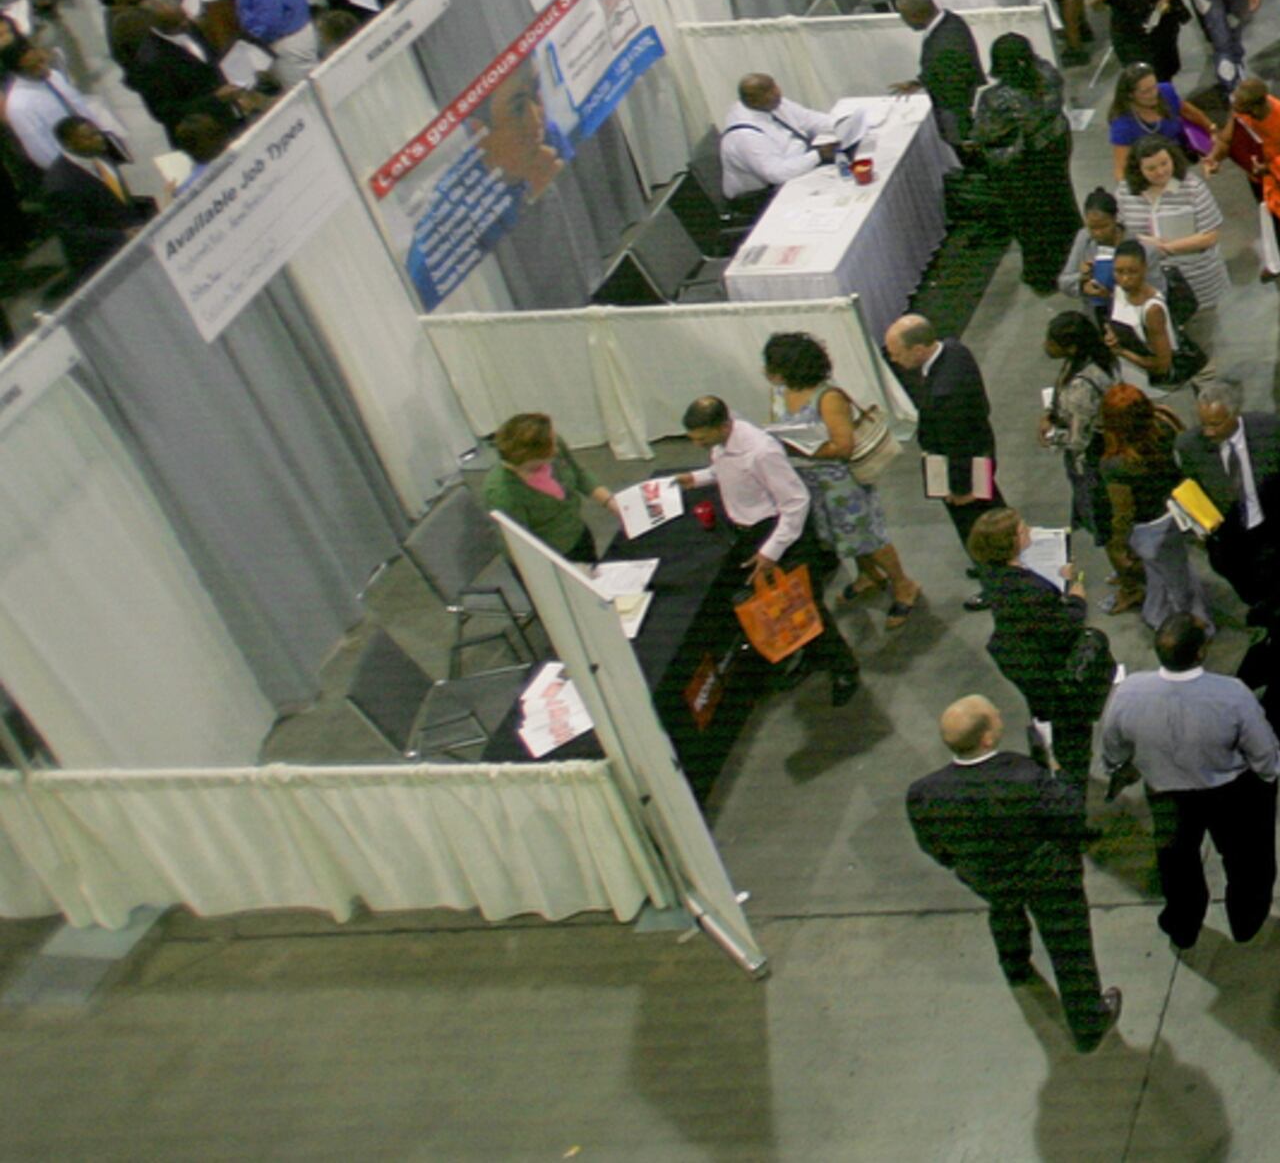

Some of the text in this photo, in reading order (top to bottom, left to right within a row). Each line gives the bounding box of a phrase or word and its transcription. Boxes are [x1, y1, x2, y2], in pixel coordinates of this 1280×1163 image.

[425, 113, 457, 144] get
[457, 52, 519, 114] serious
[165, 187, 238, 260] Available
[240, 158, 266, 190] Job
[265, 117, 305, 161] Types
